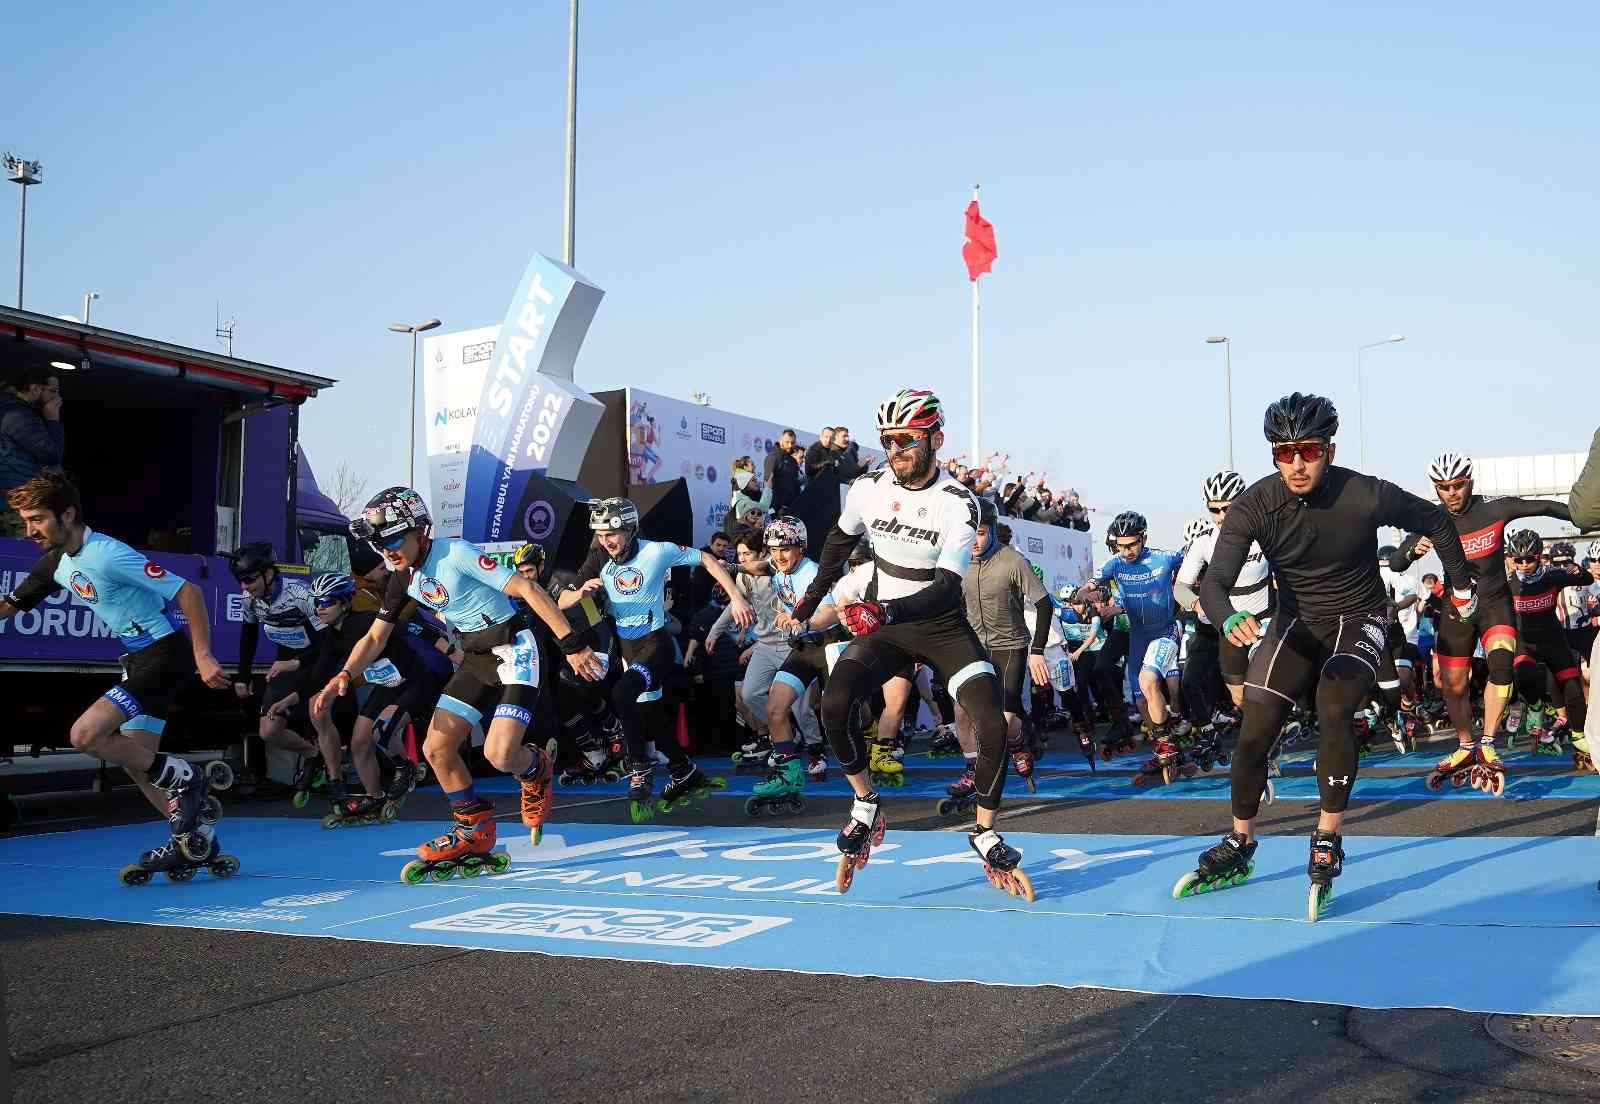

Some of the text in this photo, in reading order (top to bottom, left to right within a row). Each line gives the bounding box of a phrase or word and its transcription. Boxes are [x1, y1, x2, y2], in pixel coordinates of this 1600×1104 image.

[488, 272, 555, 418] START
[502, 453, 517, 481] YARI
[510, 384, 541, 454] MARATONU
[526, 392, 563, 462] 2022
[1460, 530, 1495, 552] ONT
[1515, 595, 1553, 610] BONT
[474, 905, 754, 933] SPOR
